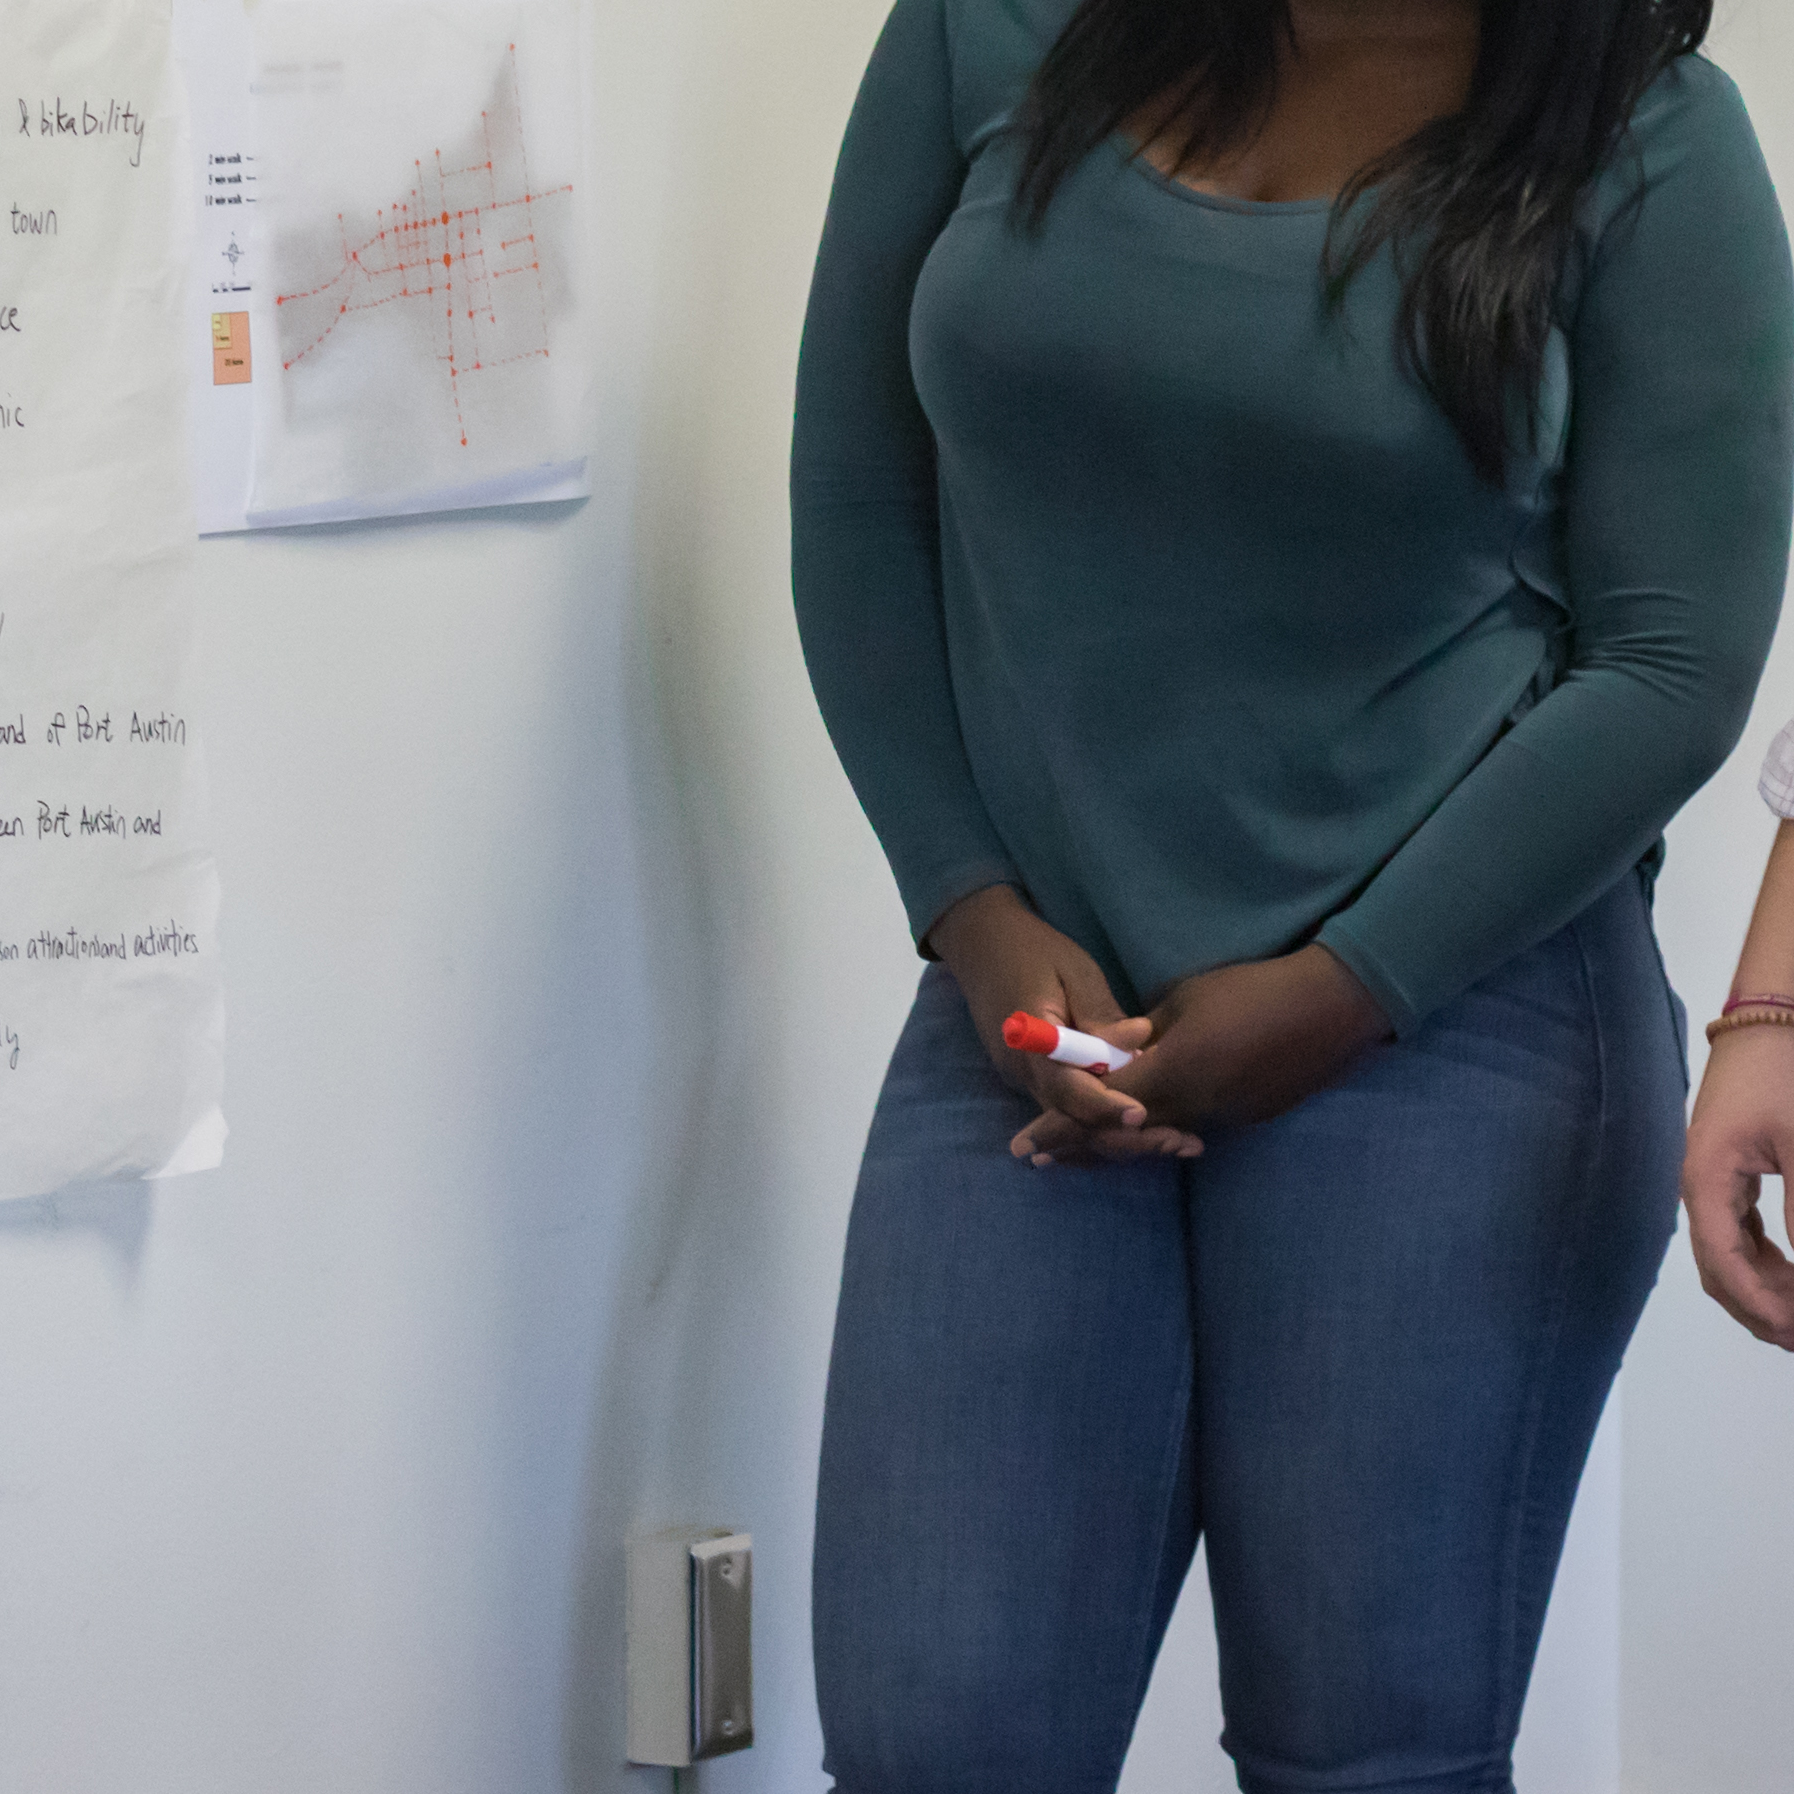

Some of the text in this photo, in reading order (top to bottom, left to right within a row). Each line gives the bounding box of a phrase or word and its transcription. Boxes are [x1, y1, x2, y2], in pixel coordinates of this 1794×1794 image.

[39, 97, 148, 168] bikability
[10, 201, 59, 237] town
[46, 712, 67, 744] of
[74, 704, 114, 743] Port
[129, 710, 187, 747] Austin
[36, 799, 72, 841] Port
[79, 805, 127, 841] Austin
[132, 808, 163, 837] and
[133, 918, 200, 959] activities
